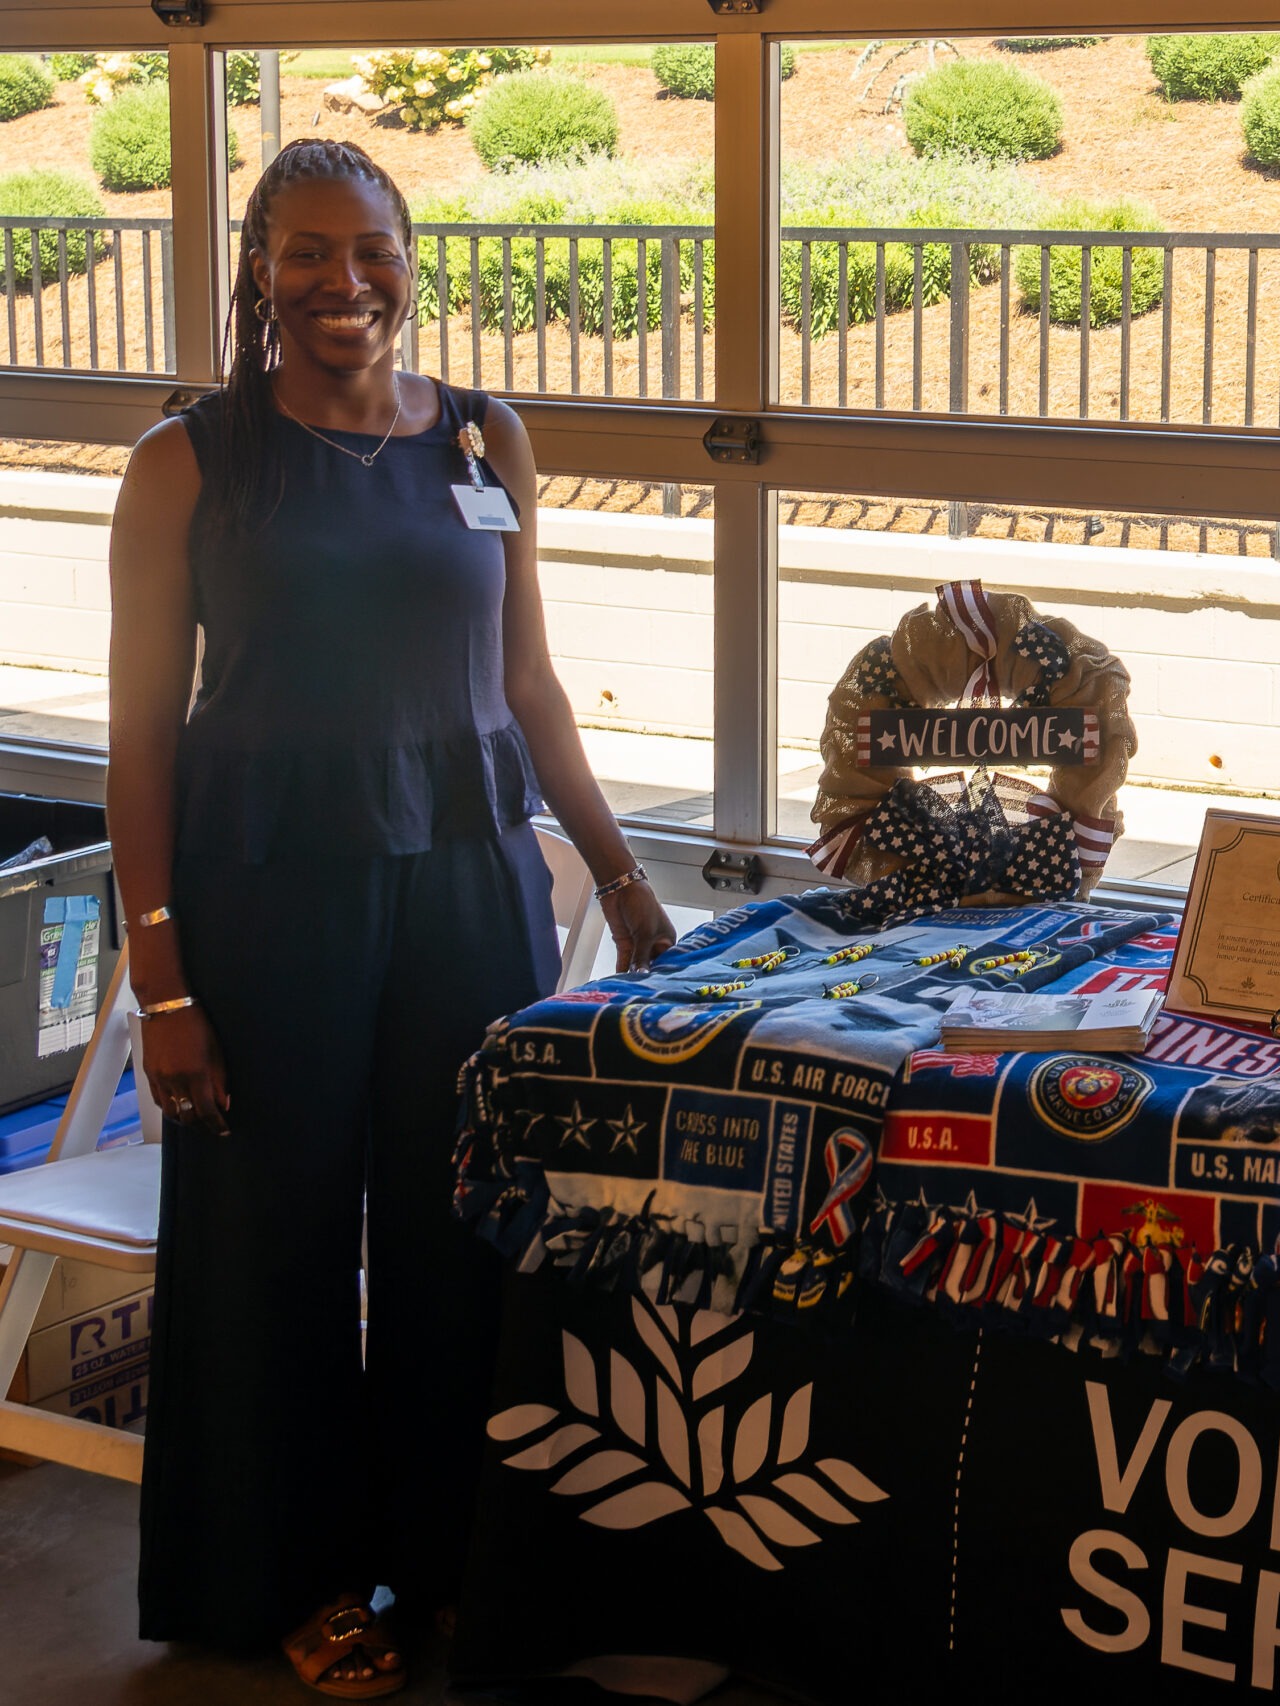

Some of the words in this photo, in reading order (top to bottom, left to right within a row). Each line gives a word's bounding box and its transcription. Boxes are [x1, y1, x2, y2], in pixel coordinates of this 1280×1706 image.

[898, 716, 1059, 758] WELCOME
[751, 1059, 785, 1086] U.S.
[792, 1063, 826, 1093] AIR
[722, 1115, 761, 1142] INTO
[908, 1126, 959, 1151] U.S.A.
[705, 1143, 746, 1169] BLUE
[775, 1113, 799, 1174] STATES
[1191, 1152, 1235, 1181] U.S.
